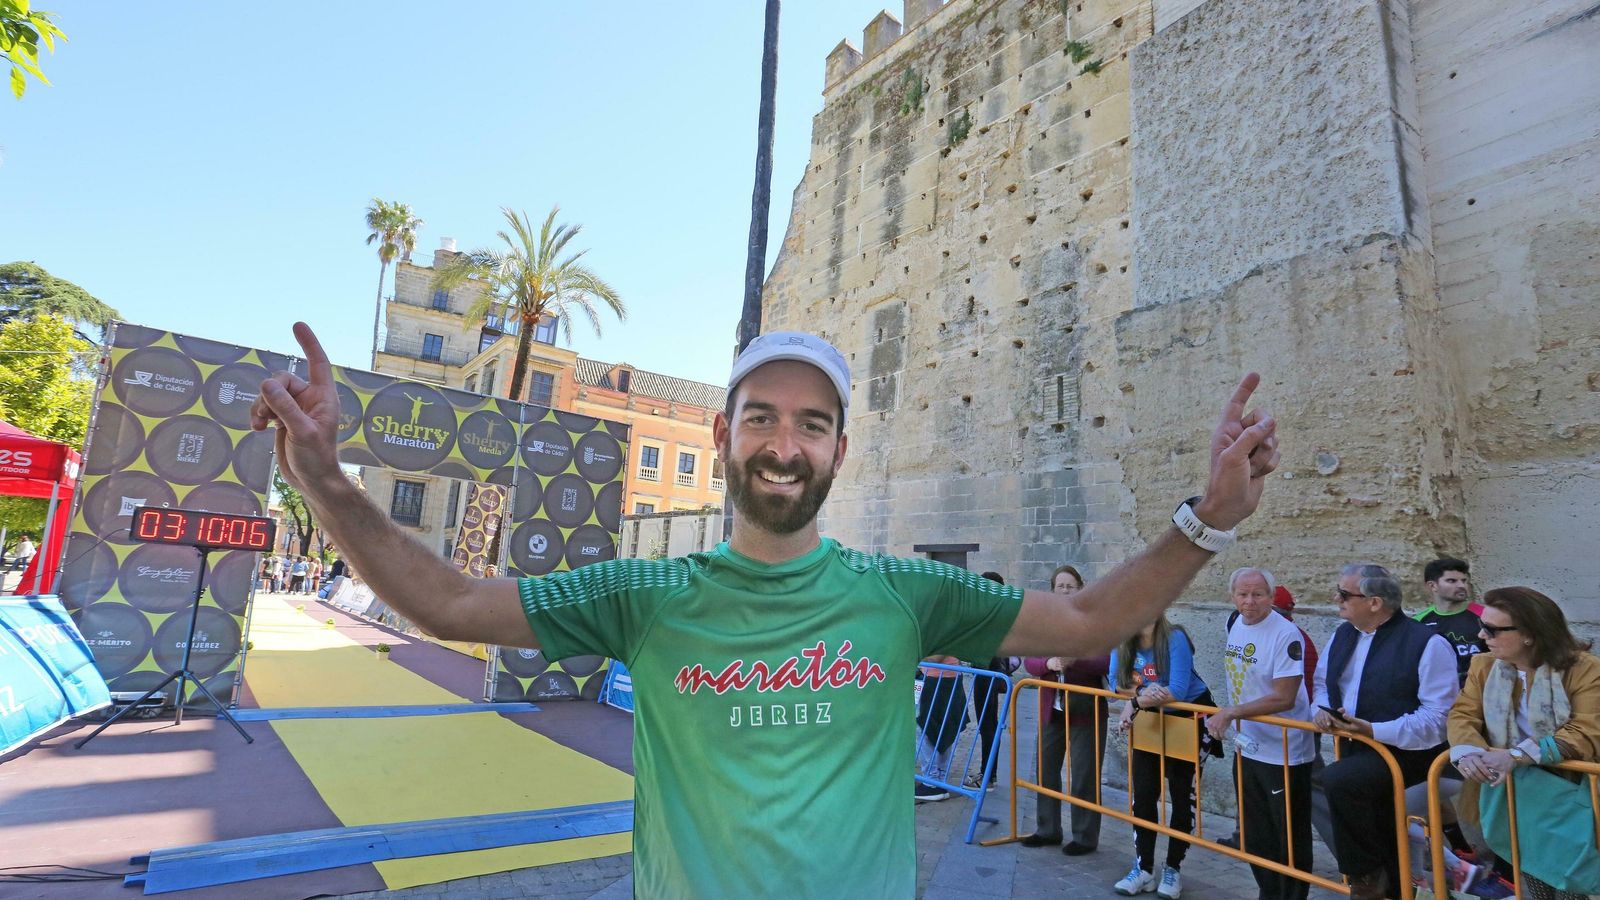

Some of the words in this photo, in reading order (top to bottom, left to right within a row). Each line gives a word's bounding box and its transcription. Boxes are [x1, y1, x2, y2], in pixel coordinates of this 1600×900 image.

[153, 382, 164, 390] de
[165, 383, 186, 393] Cádiz
[155, 373, 194, 386] Diputación
[371, 415, 450, 449] Sherry
[463, 432, 512, 454] Sherry
[479, 446, 502, 456] Media
[545, 442, 569, 452] Diputación
[139, 510, 267, 547] 03:10:06
[175, 641, 220, 649] COIJEREZ
[674, 640, 886, 695] maratón
[730, 702, 832, 727] JEREZ
